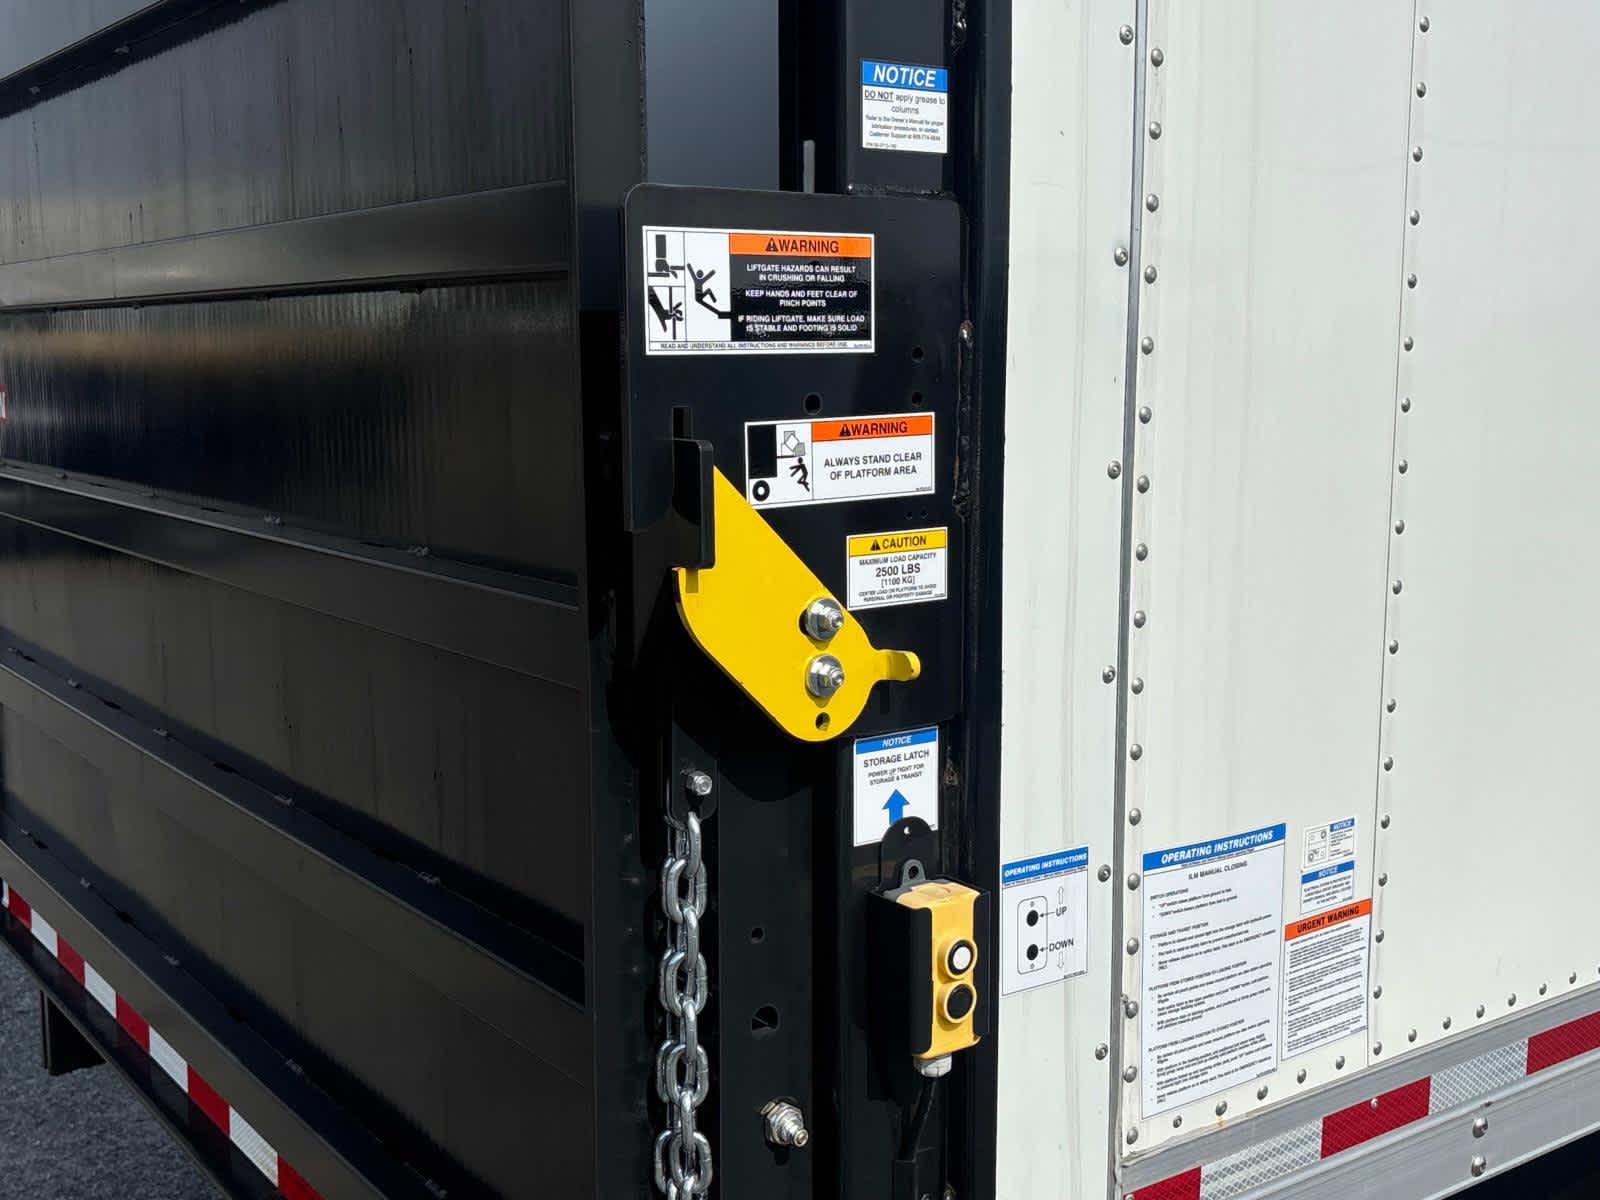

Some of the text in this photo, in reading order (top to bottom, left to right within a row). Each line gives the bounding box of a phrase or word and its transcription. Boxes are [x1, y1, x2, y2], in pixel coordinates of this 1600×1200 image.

[873, 65, 936, 87] NOTICE
[865, 90, 876, 98] DO
[877, 91, 893, 99] NOT
[896, 95, 914, 104] apply
[915, 96, 937, 104] grease
[891, 106, 919, 114] columns
[779, 239, 839, 253] WARNING
[747, 264, 780, 273] LIFTGATE
[781, 265, 813, 273] HAZARDS
[831, 266, 856, 274] RESULT
[767, 274, 804, 282] CRUSHING
[817, 275, 845, 283] FALLING
[770, 315, 803, 323] LIFTGATE,
[846, 315, 865, 323] LOAD
[746, 324, 753, 332] IS
[754, 324, 781, 332] STABLE
[851, 421, 908, 436] WARNING
[824, 452, 922, 468] ALWAYS STAND CLEAR
[830, 465, 917, 480] OF PLATFORM AREA
[882, 536, 926, 549] CAUTION
[859, 557, 888, 565] MAXIMUM
[908, 552, 936, 561] CAPACITY
[876, 563, 921, 577] 2500 LBS
[881, 576, 915, 588] [1100 KG]
[882, 736, 912, 747] NOTICE
[864, 749, 929, 768] STORAGE LATCH
[868, 770, 888, 778] POWER
[1161, 845, 1212, 864] OPERATING
[1214, 830, 1274, 853] INSTRUCTIONS
[1004, 863, 1040, 877] OPERATING
[1041, 853, 1087, 868] INSTRUCTIONS
[1200, 867, 1223, 877] MANUAL
[1056, 906, 1067, 917] UP
[1297, 906, 1360, 933] URGENT WARNING
[1049, 938, 1074, 952] DOWN
